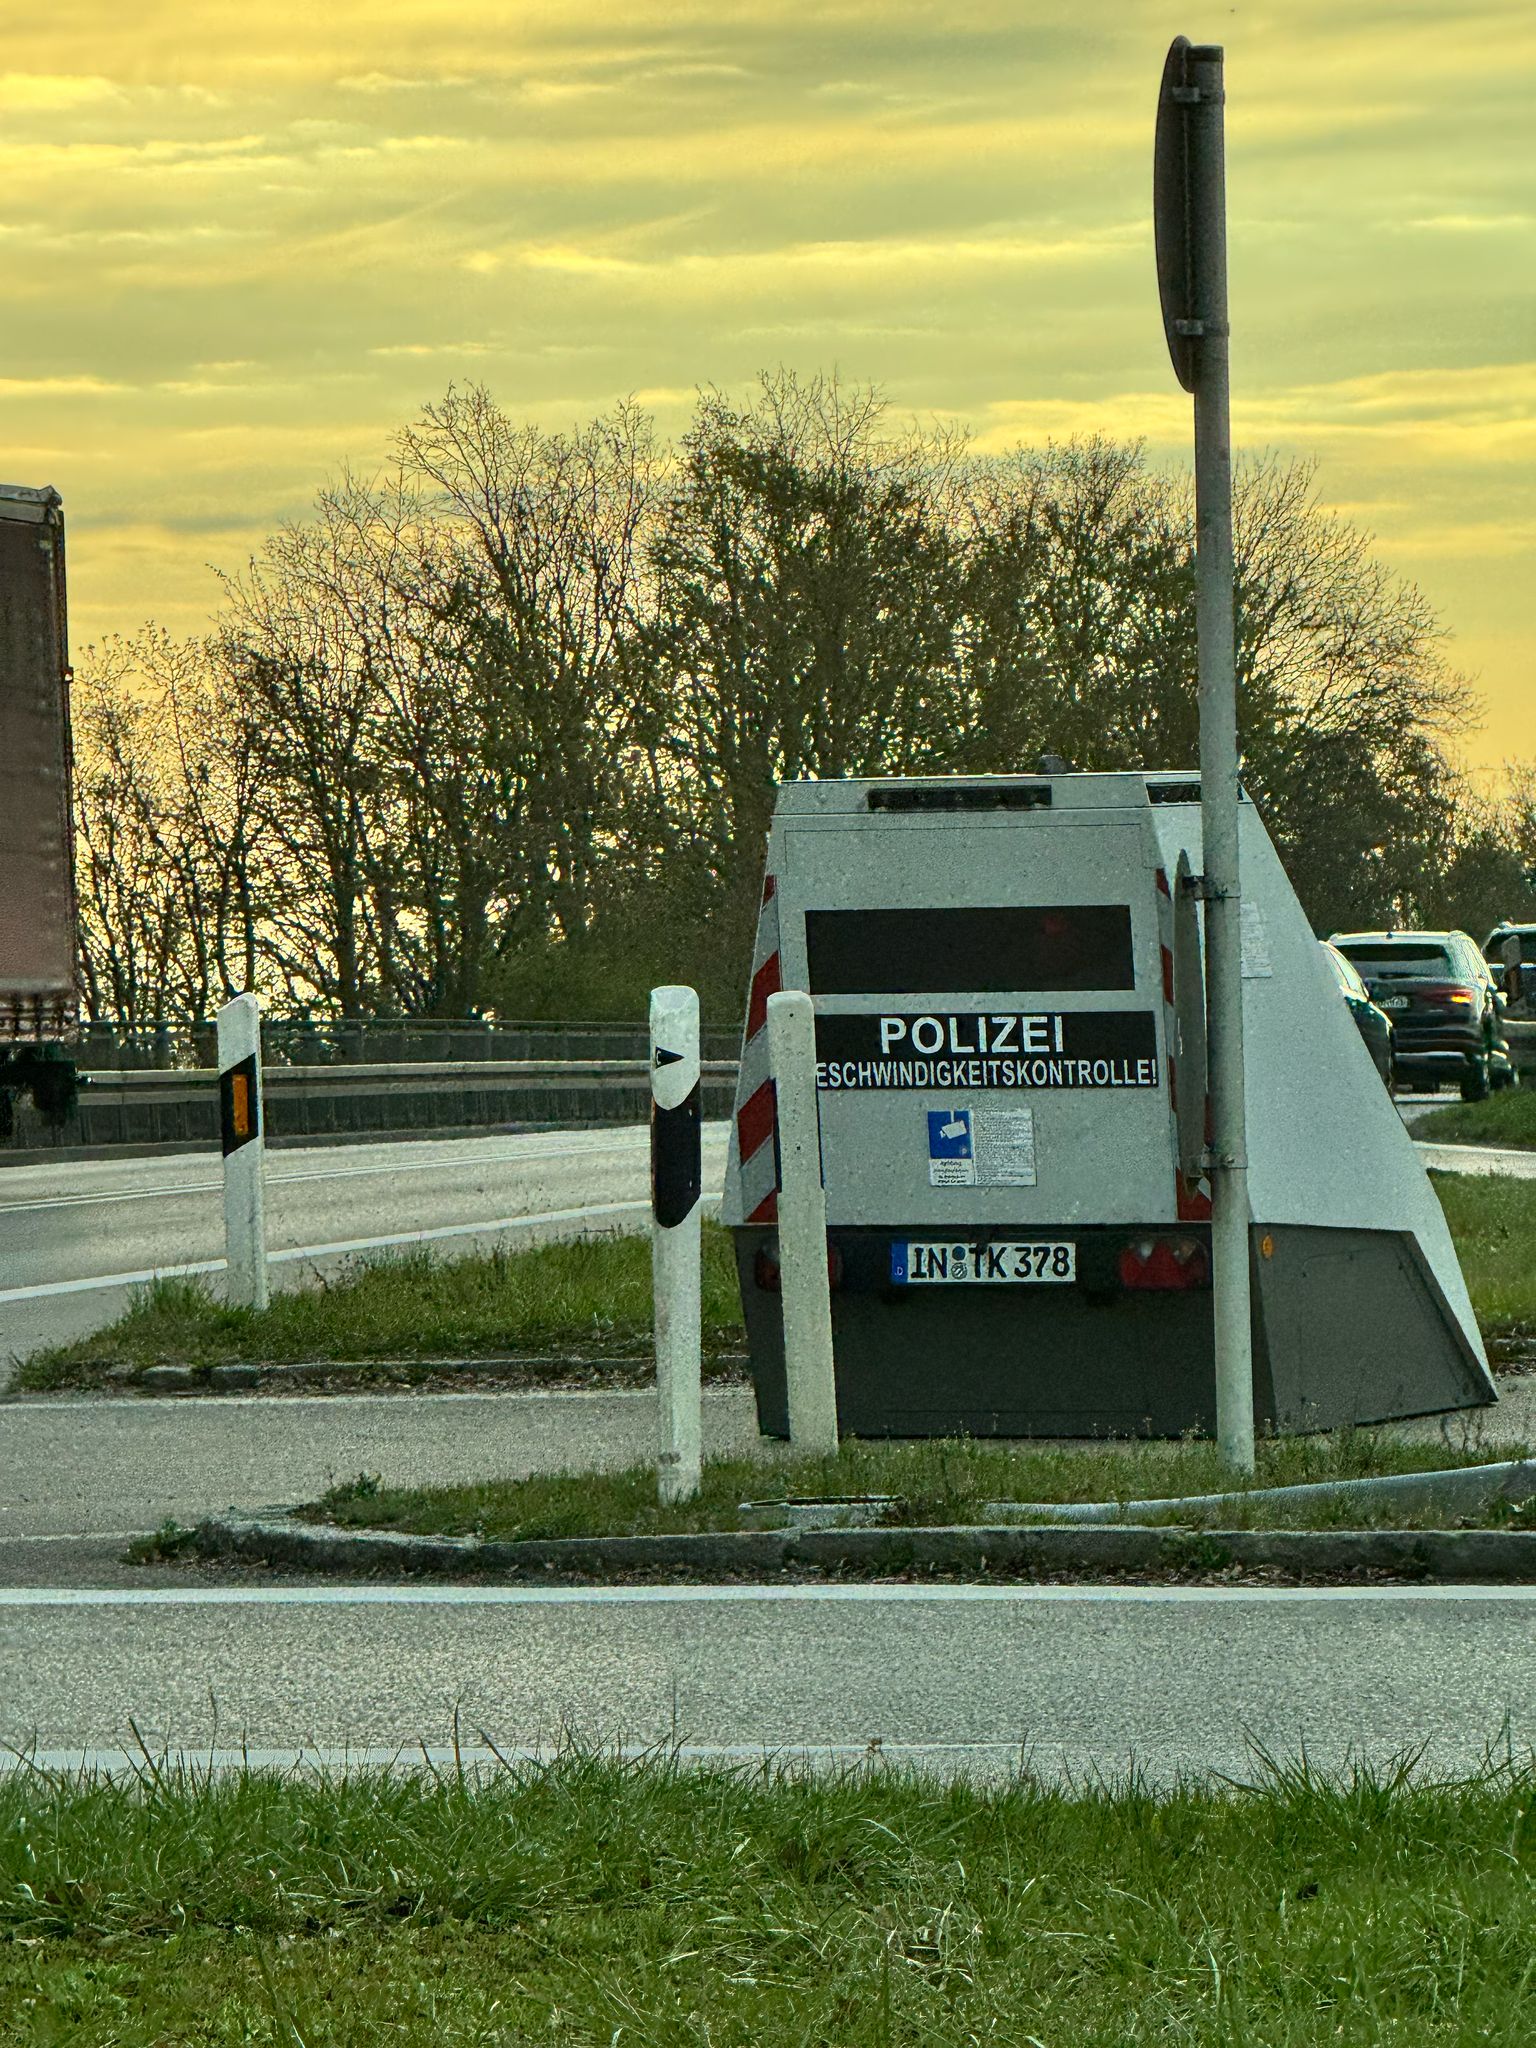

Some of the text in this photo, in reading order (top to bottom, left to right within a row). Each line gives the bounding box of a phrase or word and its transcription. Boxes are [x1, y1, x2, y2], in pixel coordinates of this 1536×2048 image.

[880, 1015, 1064, 1054] POLIZEI
[815, 1059, 1158, 1088] ESCHWINDIGKEITSKONTROLLE!
[910, 1247, 948, 1279] IN
[968, 1246, 1008, 1279] TK
[1013, 1246, 1071, 1278] 378
